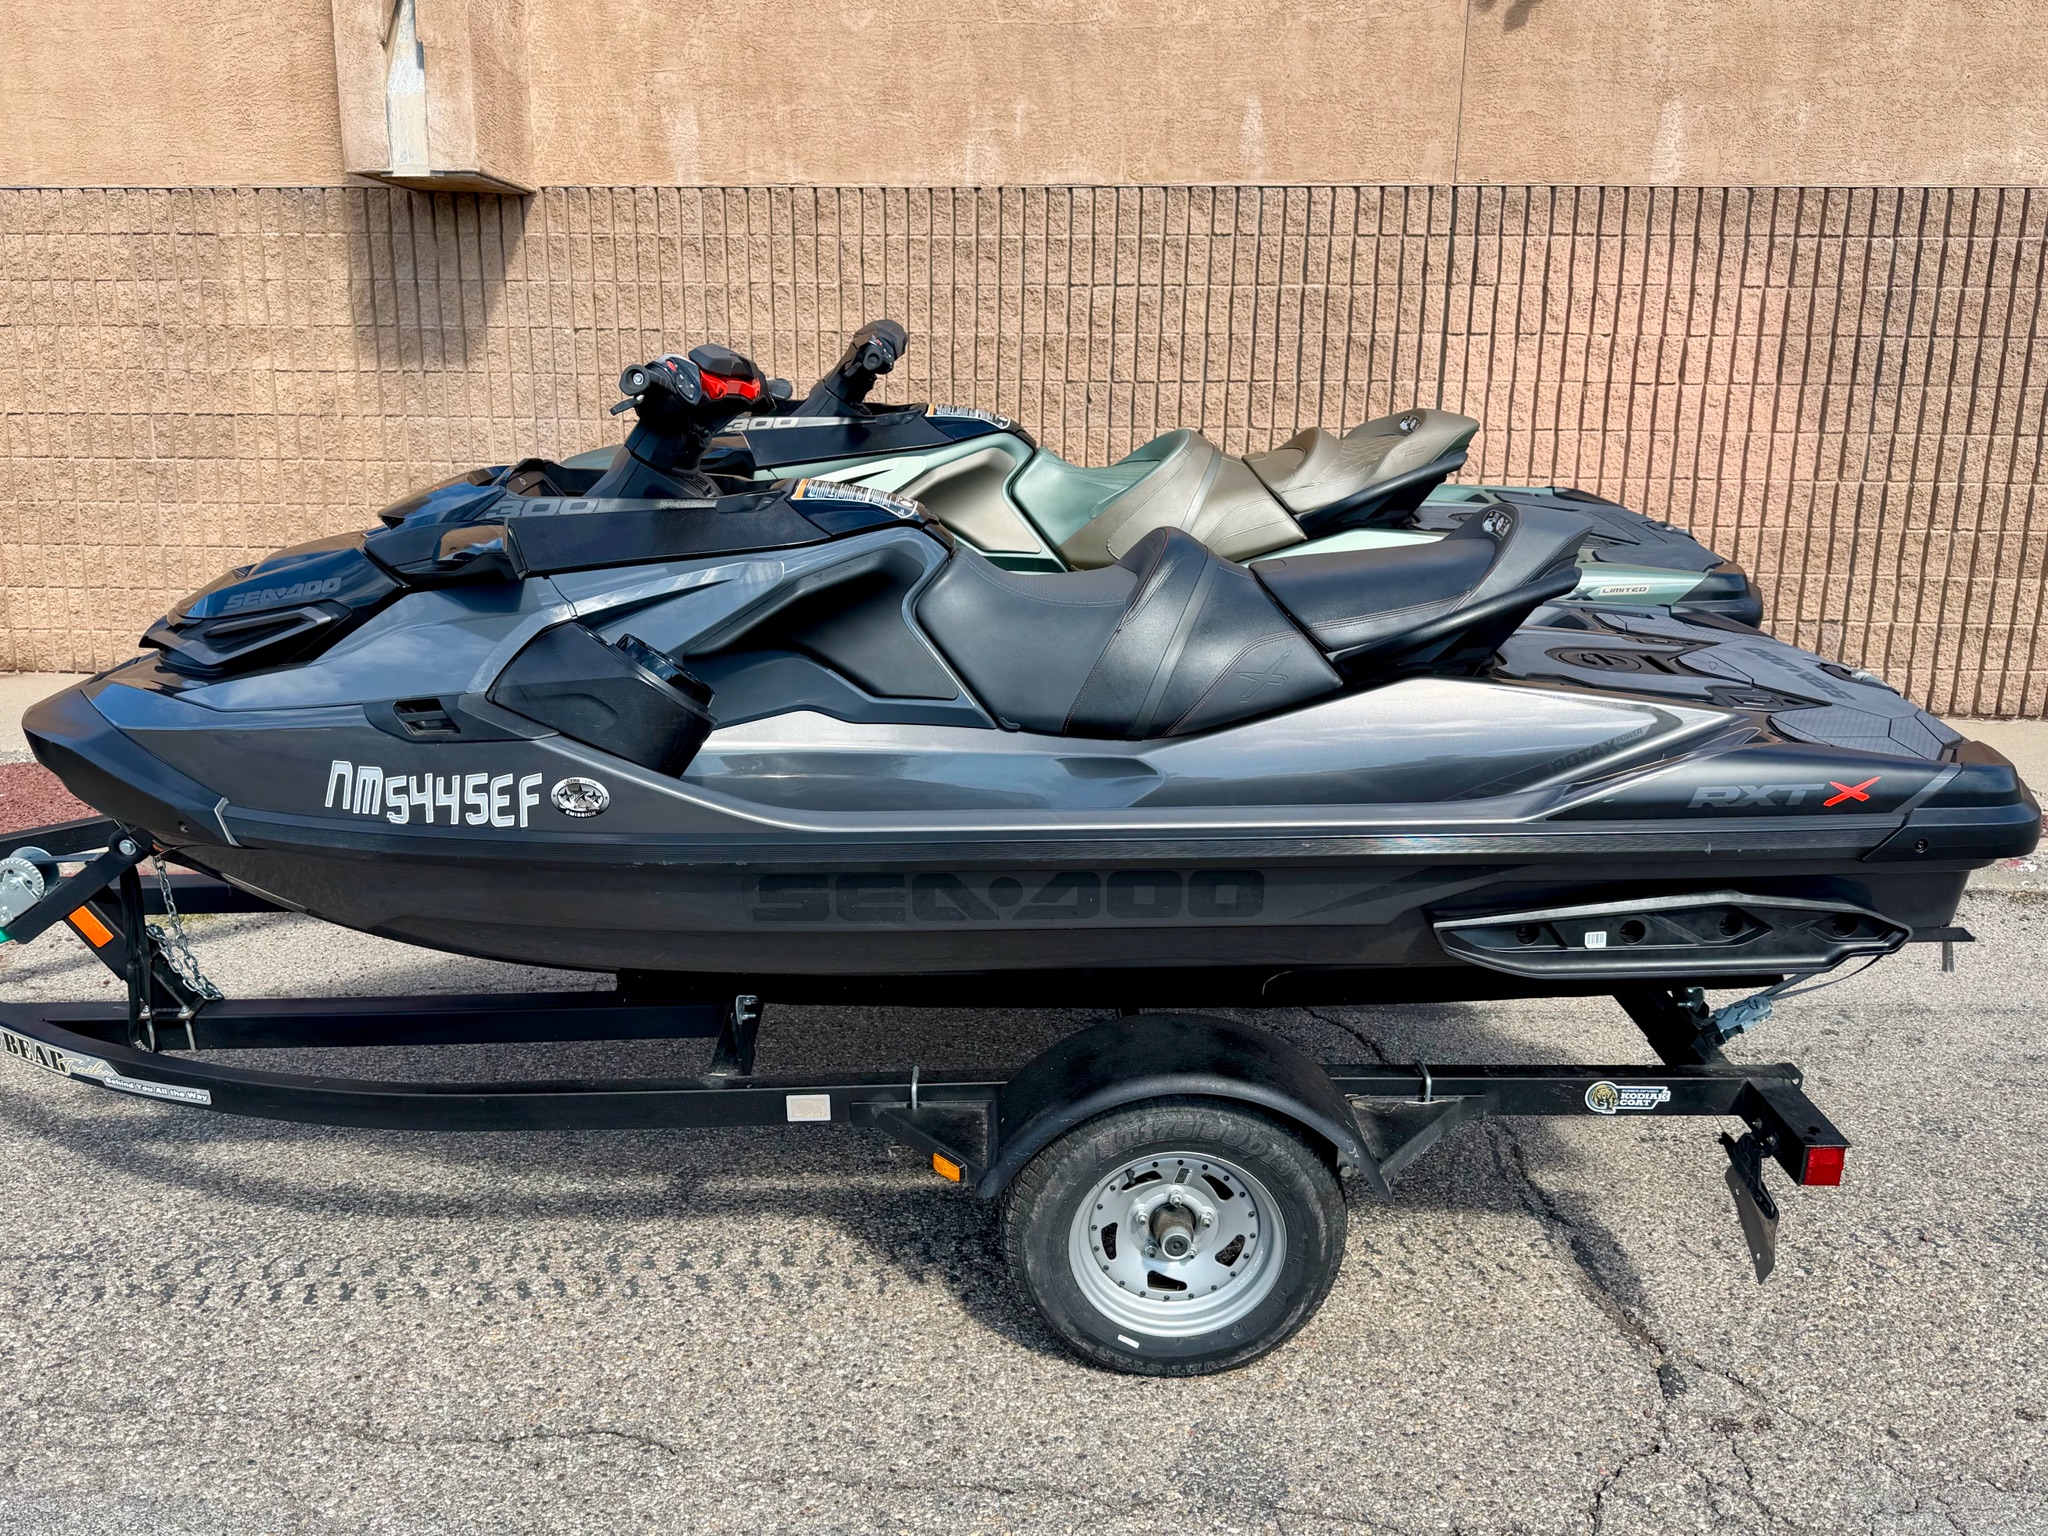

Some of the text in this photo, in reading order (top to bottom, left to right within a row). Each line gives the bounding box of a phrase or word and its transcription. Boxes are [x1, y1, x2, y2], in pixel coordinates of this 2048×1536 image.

[724, 417, 800, 432] 300
[486, 500, 598, 519] 300
[1602, 586, 1647, 594] LIMITED
[1616, 727, 1644, 745] POWER
[1687, 775, 1882, 808] RXT X
[2, 1031, 67, 1074] BEAR
[105, 1077, 134, 1089] Behind
[136, 1083, 153, 1093] You
[169, 1090, 185, 1098] the
[187, 1091, 208, 1102] Way
[1620, 1092, 1668, 1100] KODIAK
